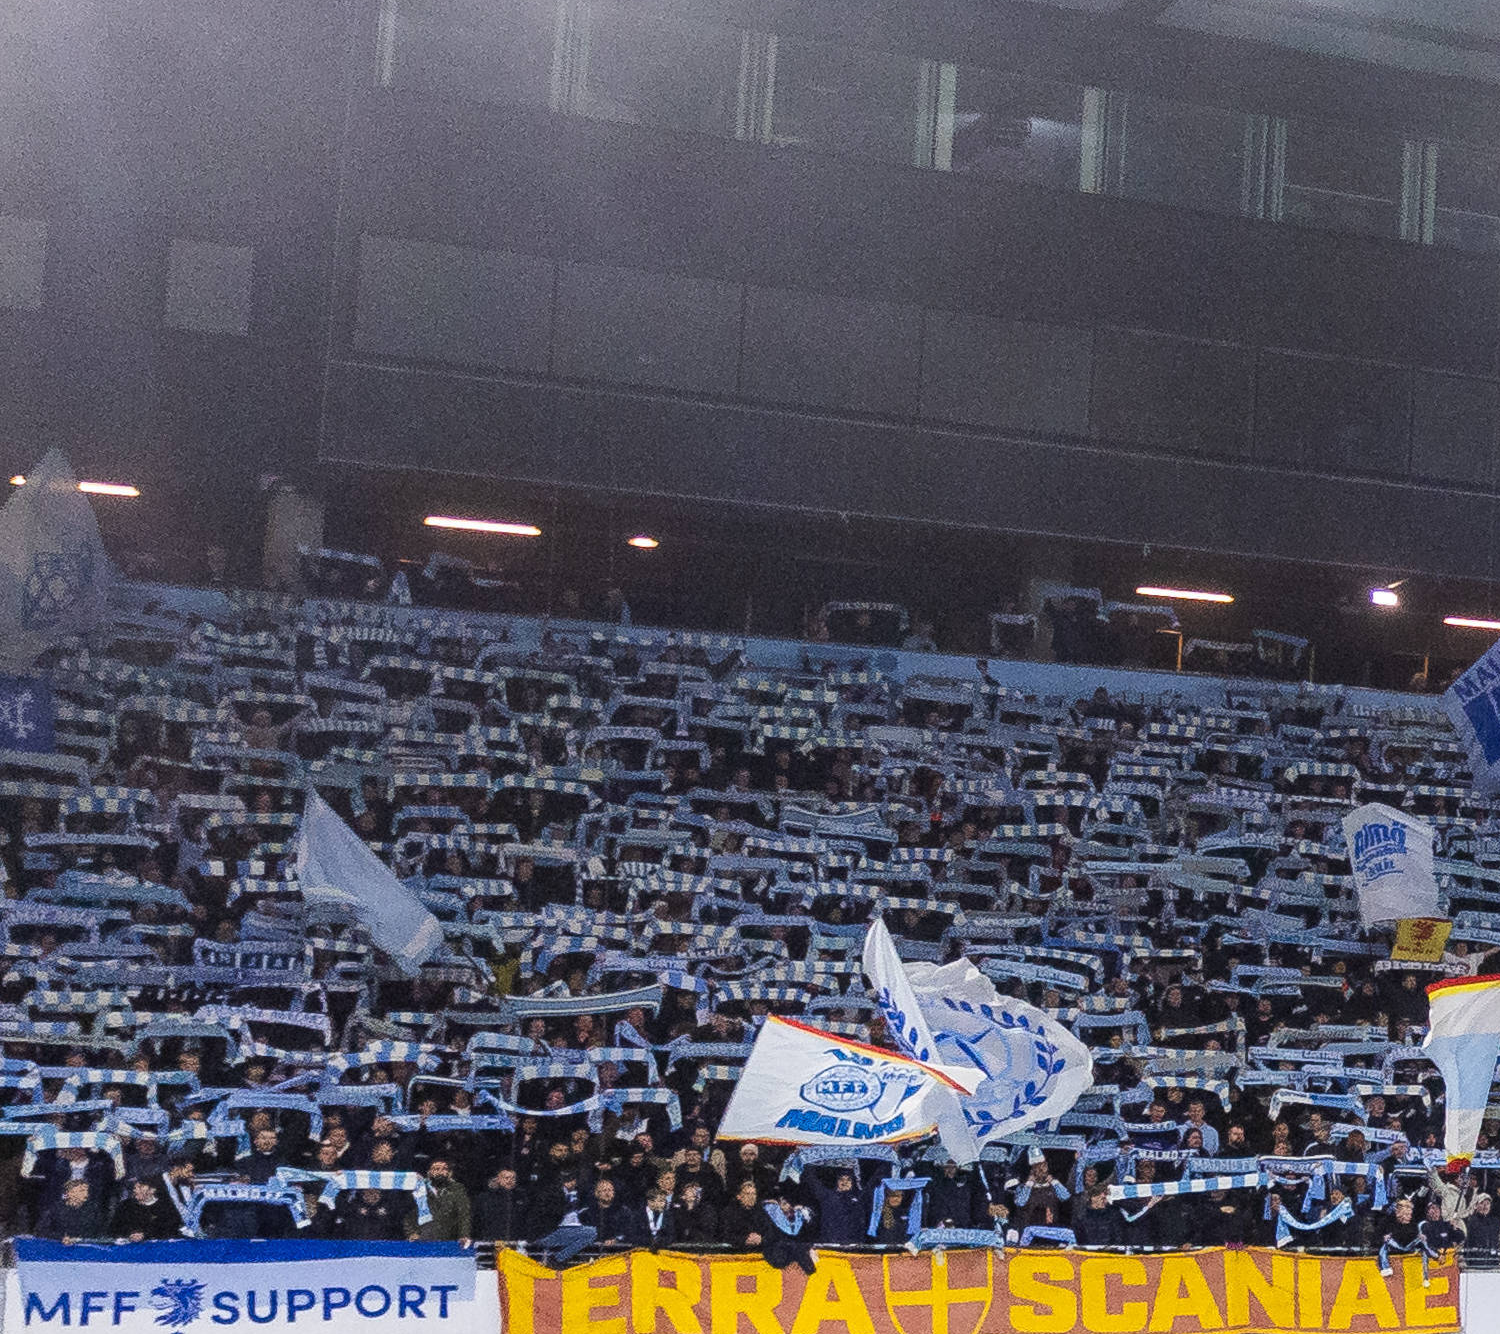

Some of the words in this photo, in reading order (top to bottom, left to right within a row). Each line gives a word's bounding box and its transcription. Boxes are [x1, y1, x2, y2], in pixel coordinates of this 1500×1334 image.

[23, 1291, 141, 1327] MFF
[210, 1284, 459, 1327] SUPPORT
[1006, 1249, 1459, 1334] SCANIAE
